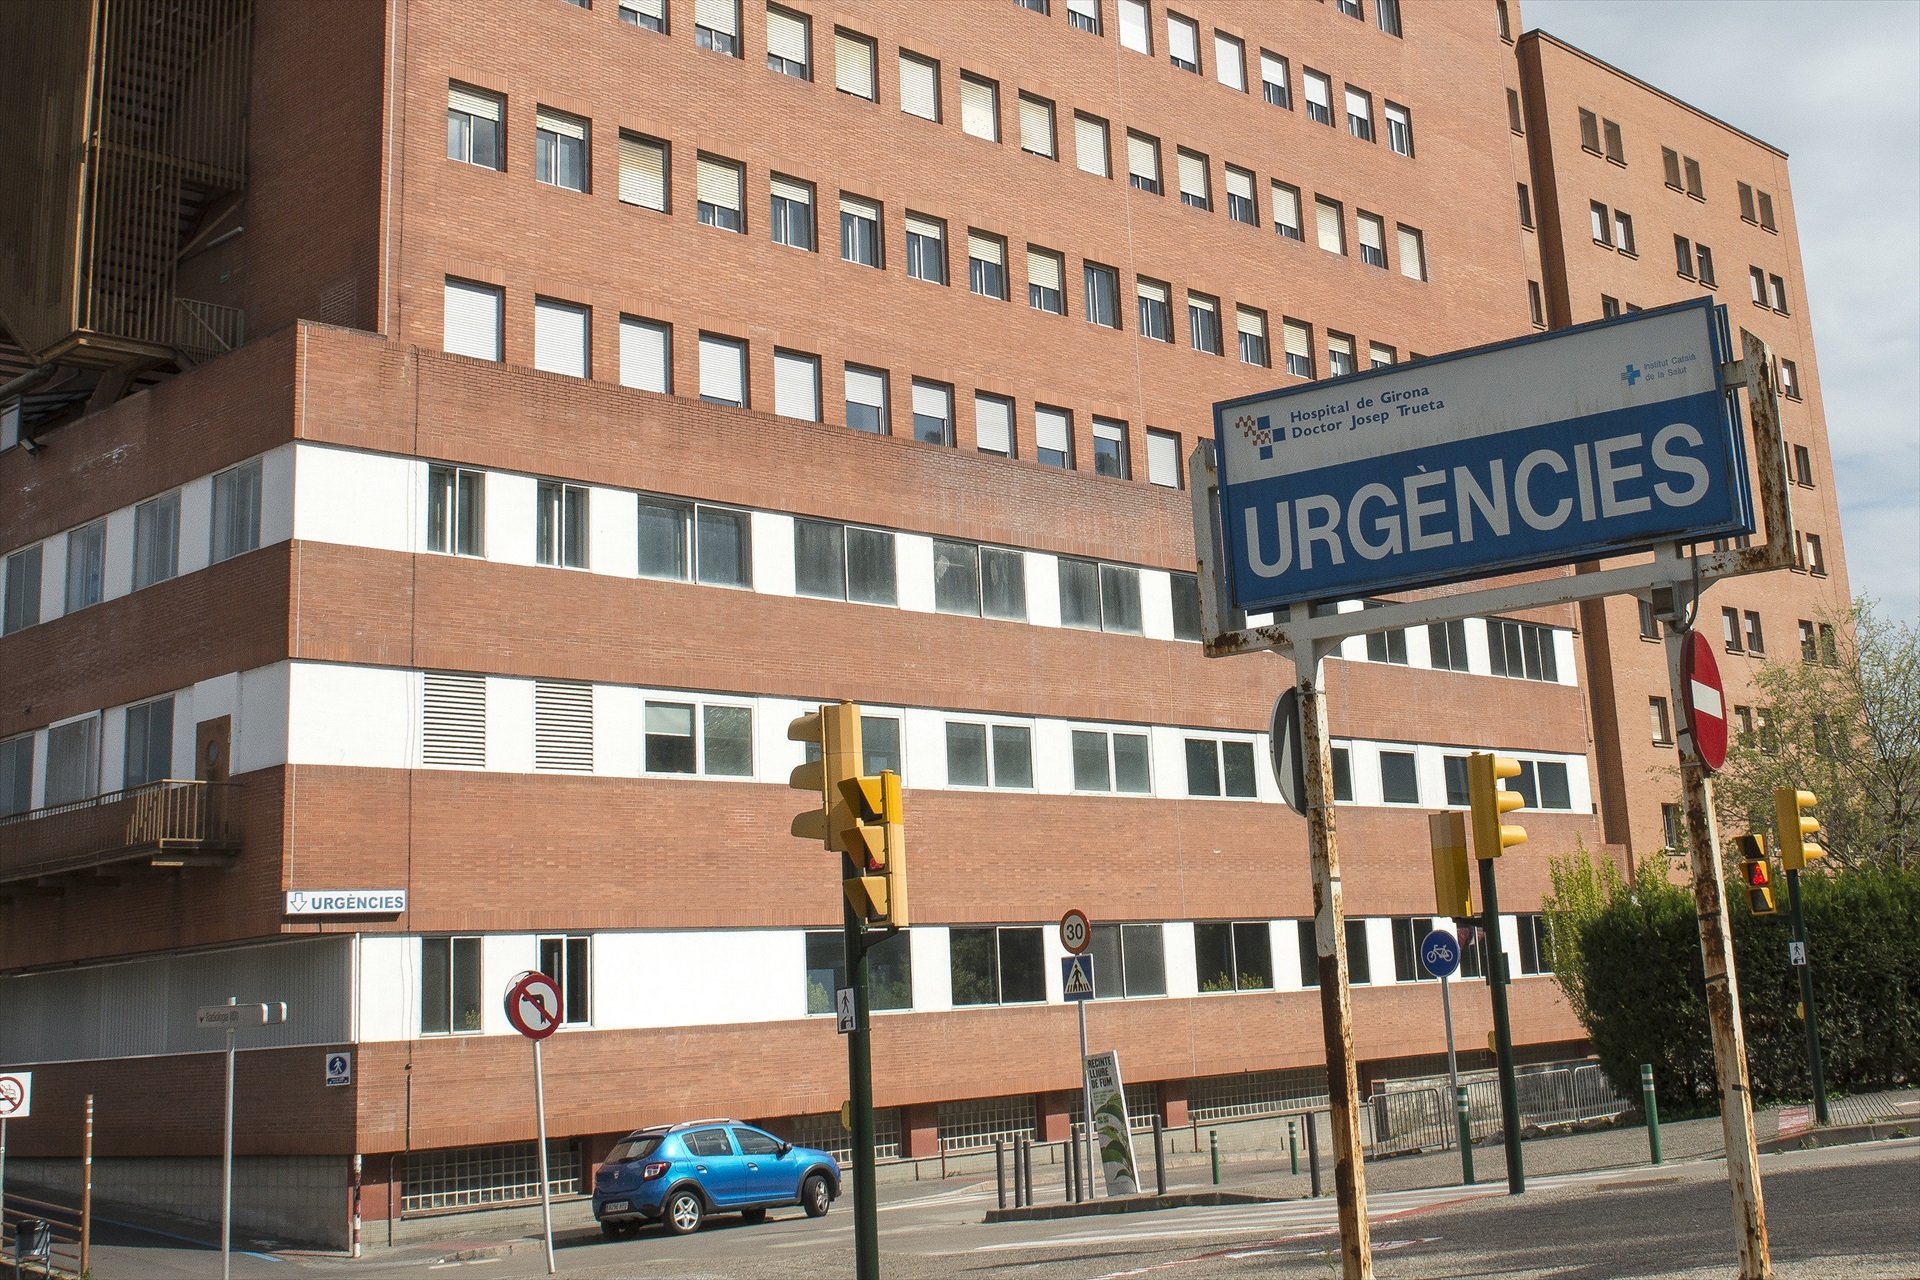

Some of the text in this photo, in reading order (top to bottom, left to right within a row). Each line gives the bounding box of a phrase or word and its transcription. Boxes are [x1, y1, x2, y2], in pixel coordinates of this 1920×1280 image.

[1643, 359, 1669, 370] Institut
[1645, 366, 1687, 381] de la Salut
[1290, 387, 1430, 423] Hospital de Girona
[1291, 400, 1445, 439] Doctor Josep Trueta
[1245, 421, 1710, 579] URGÈNCIES
[311, 893, 404, 910] URGÈNCIES
[1066, 923, 1083, 941] 30
[1088, 1056, 1111, 1068] RECINTE
[1089, 1067, 1109, 1078] LLIURE
[1091, 1077, 1112, 1089] DE FUM
